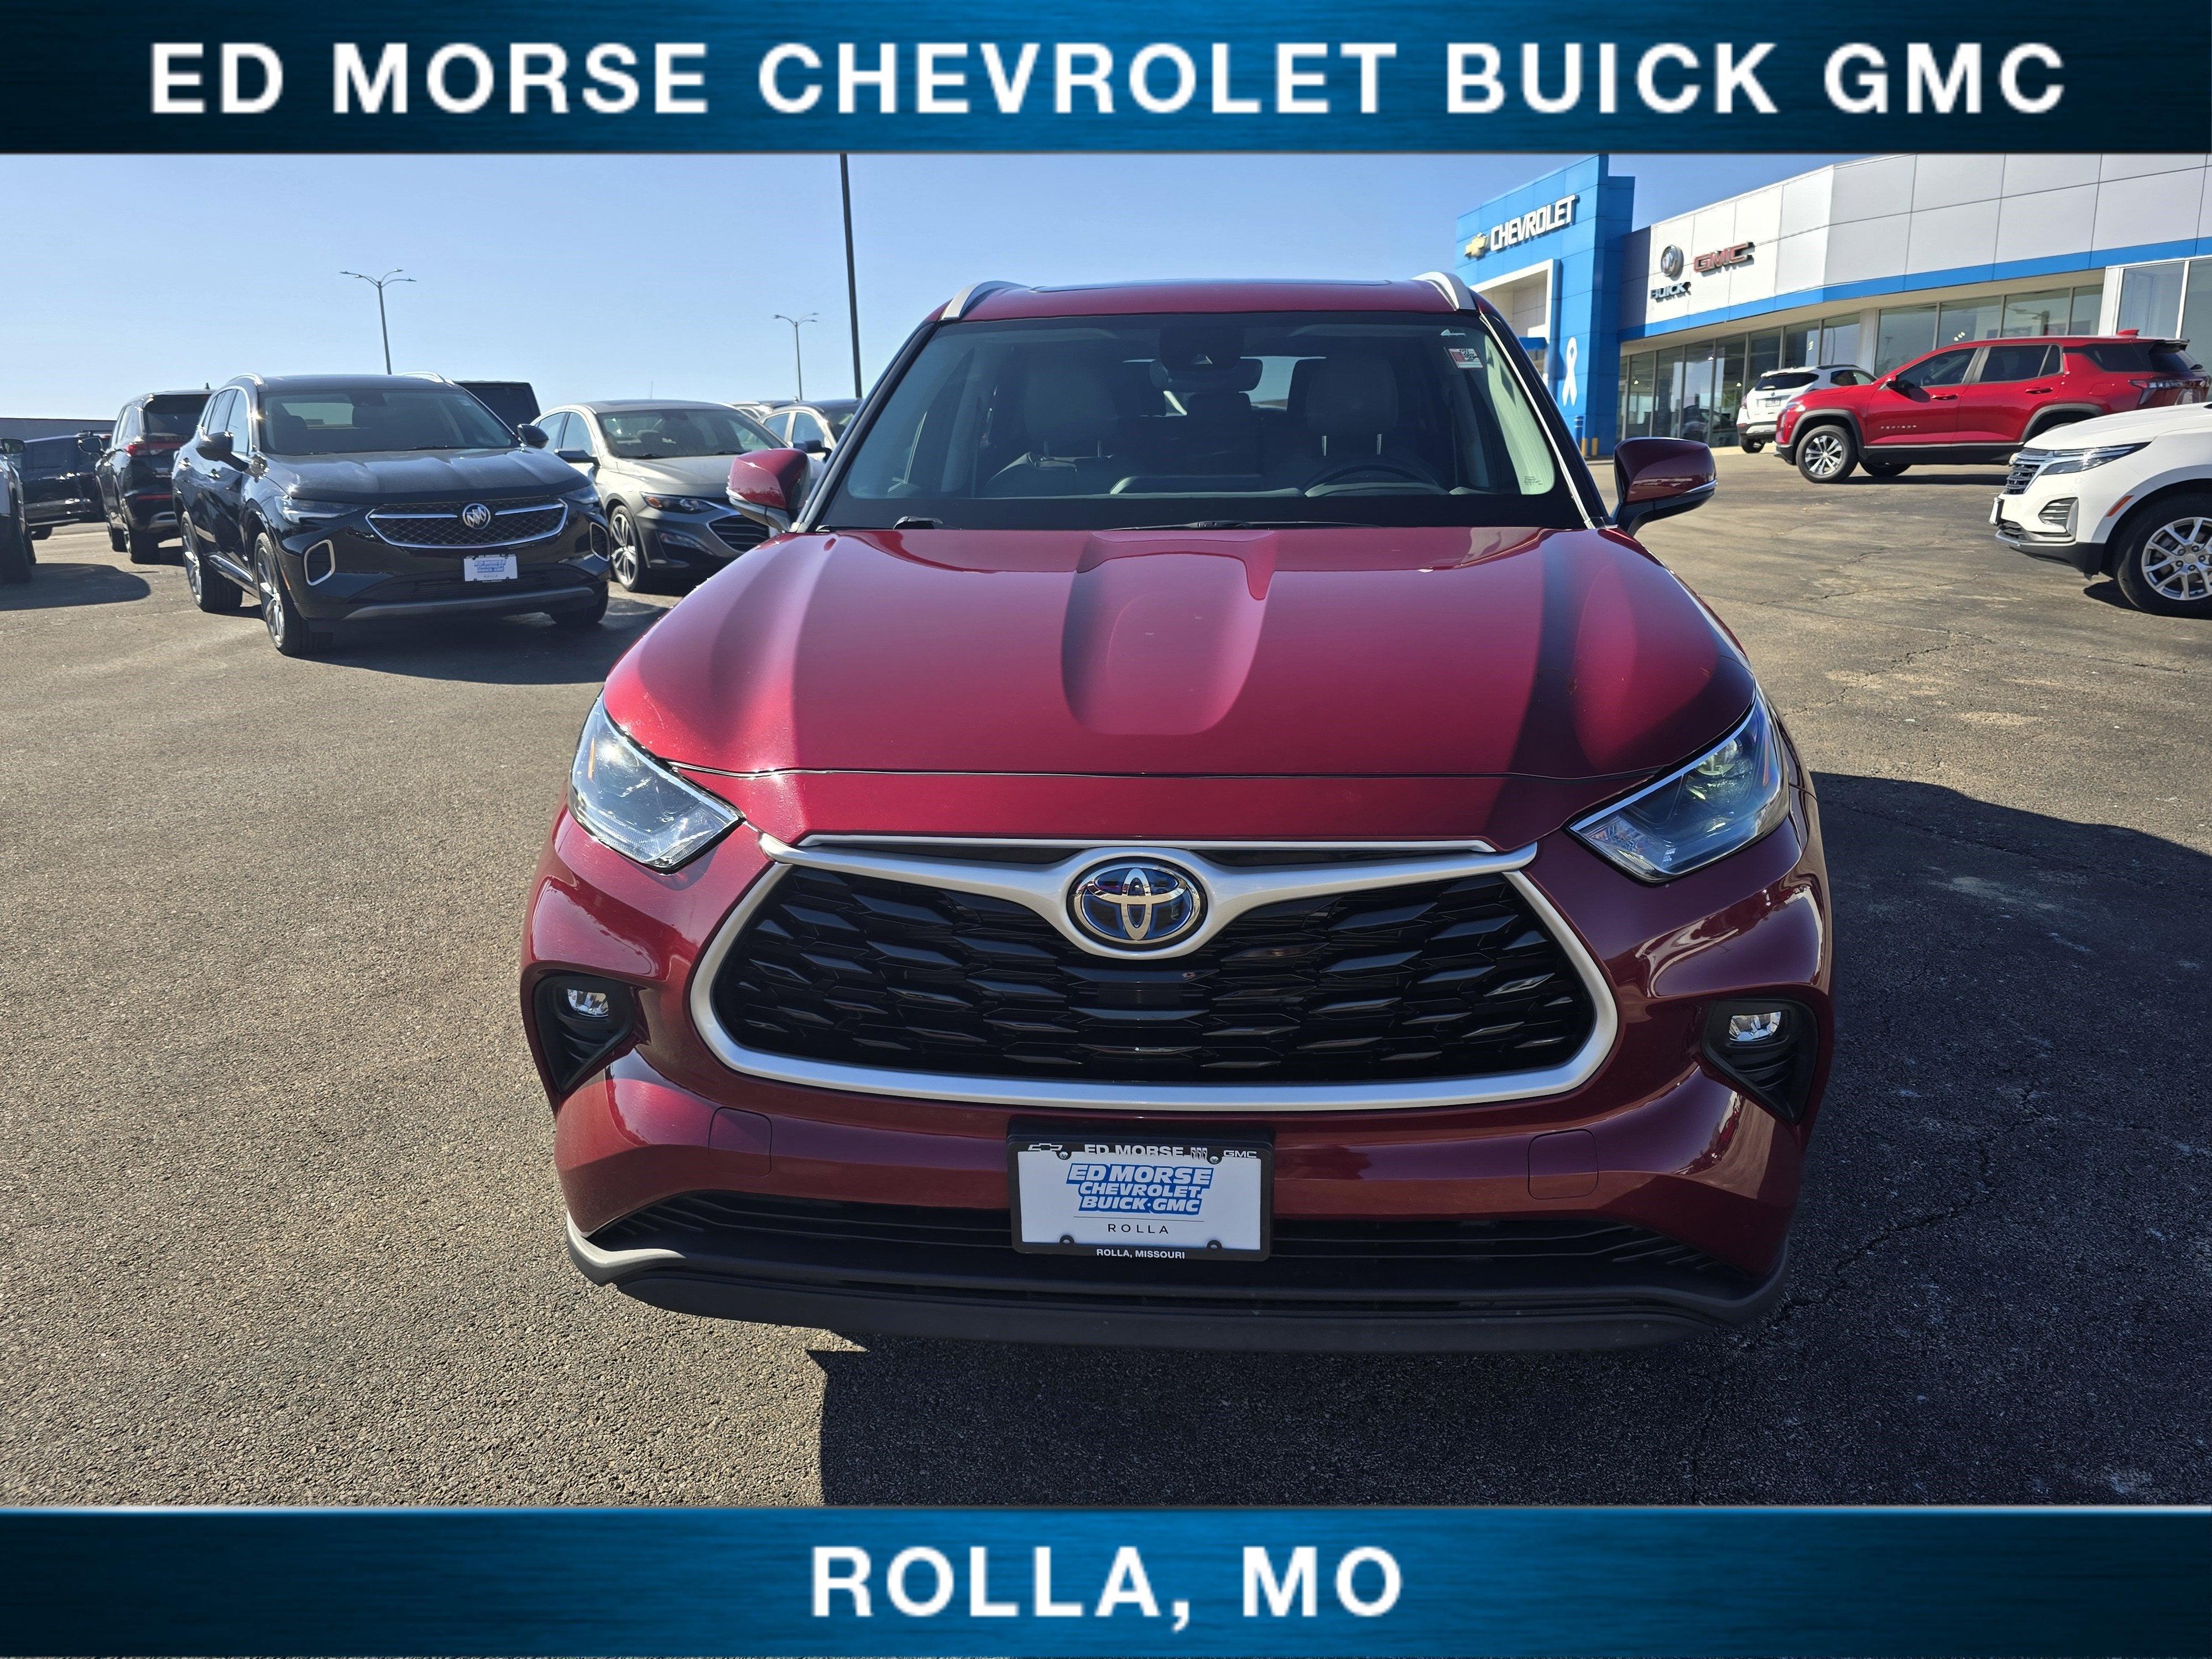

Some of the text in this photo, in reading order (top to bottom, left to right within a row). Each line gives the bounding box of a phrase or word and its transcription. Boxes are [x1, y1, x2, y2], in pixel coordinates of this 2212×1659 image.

[1490, 194, 1576, 251] CHEVROLET
[1693, 241, 1749, 273] GMC
[1651, 281, 1687, 299] BUICK
[1084, 1144, 1184, 1157] ED MORSE
[1223, 1150, 1257, 1159] GMC
[1068, 1165, 1212, 1185] ED MORSE
[1080, 1182, 1201, 1198] CHEVROLET
[1108, 1224, 1169, 1234] ROLLA
[1096, 1249, 1185, 1259] ROLLA, MISSOURI
